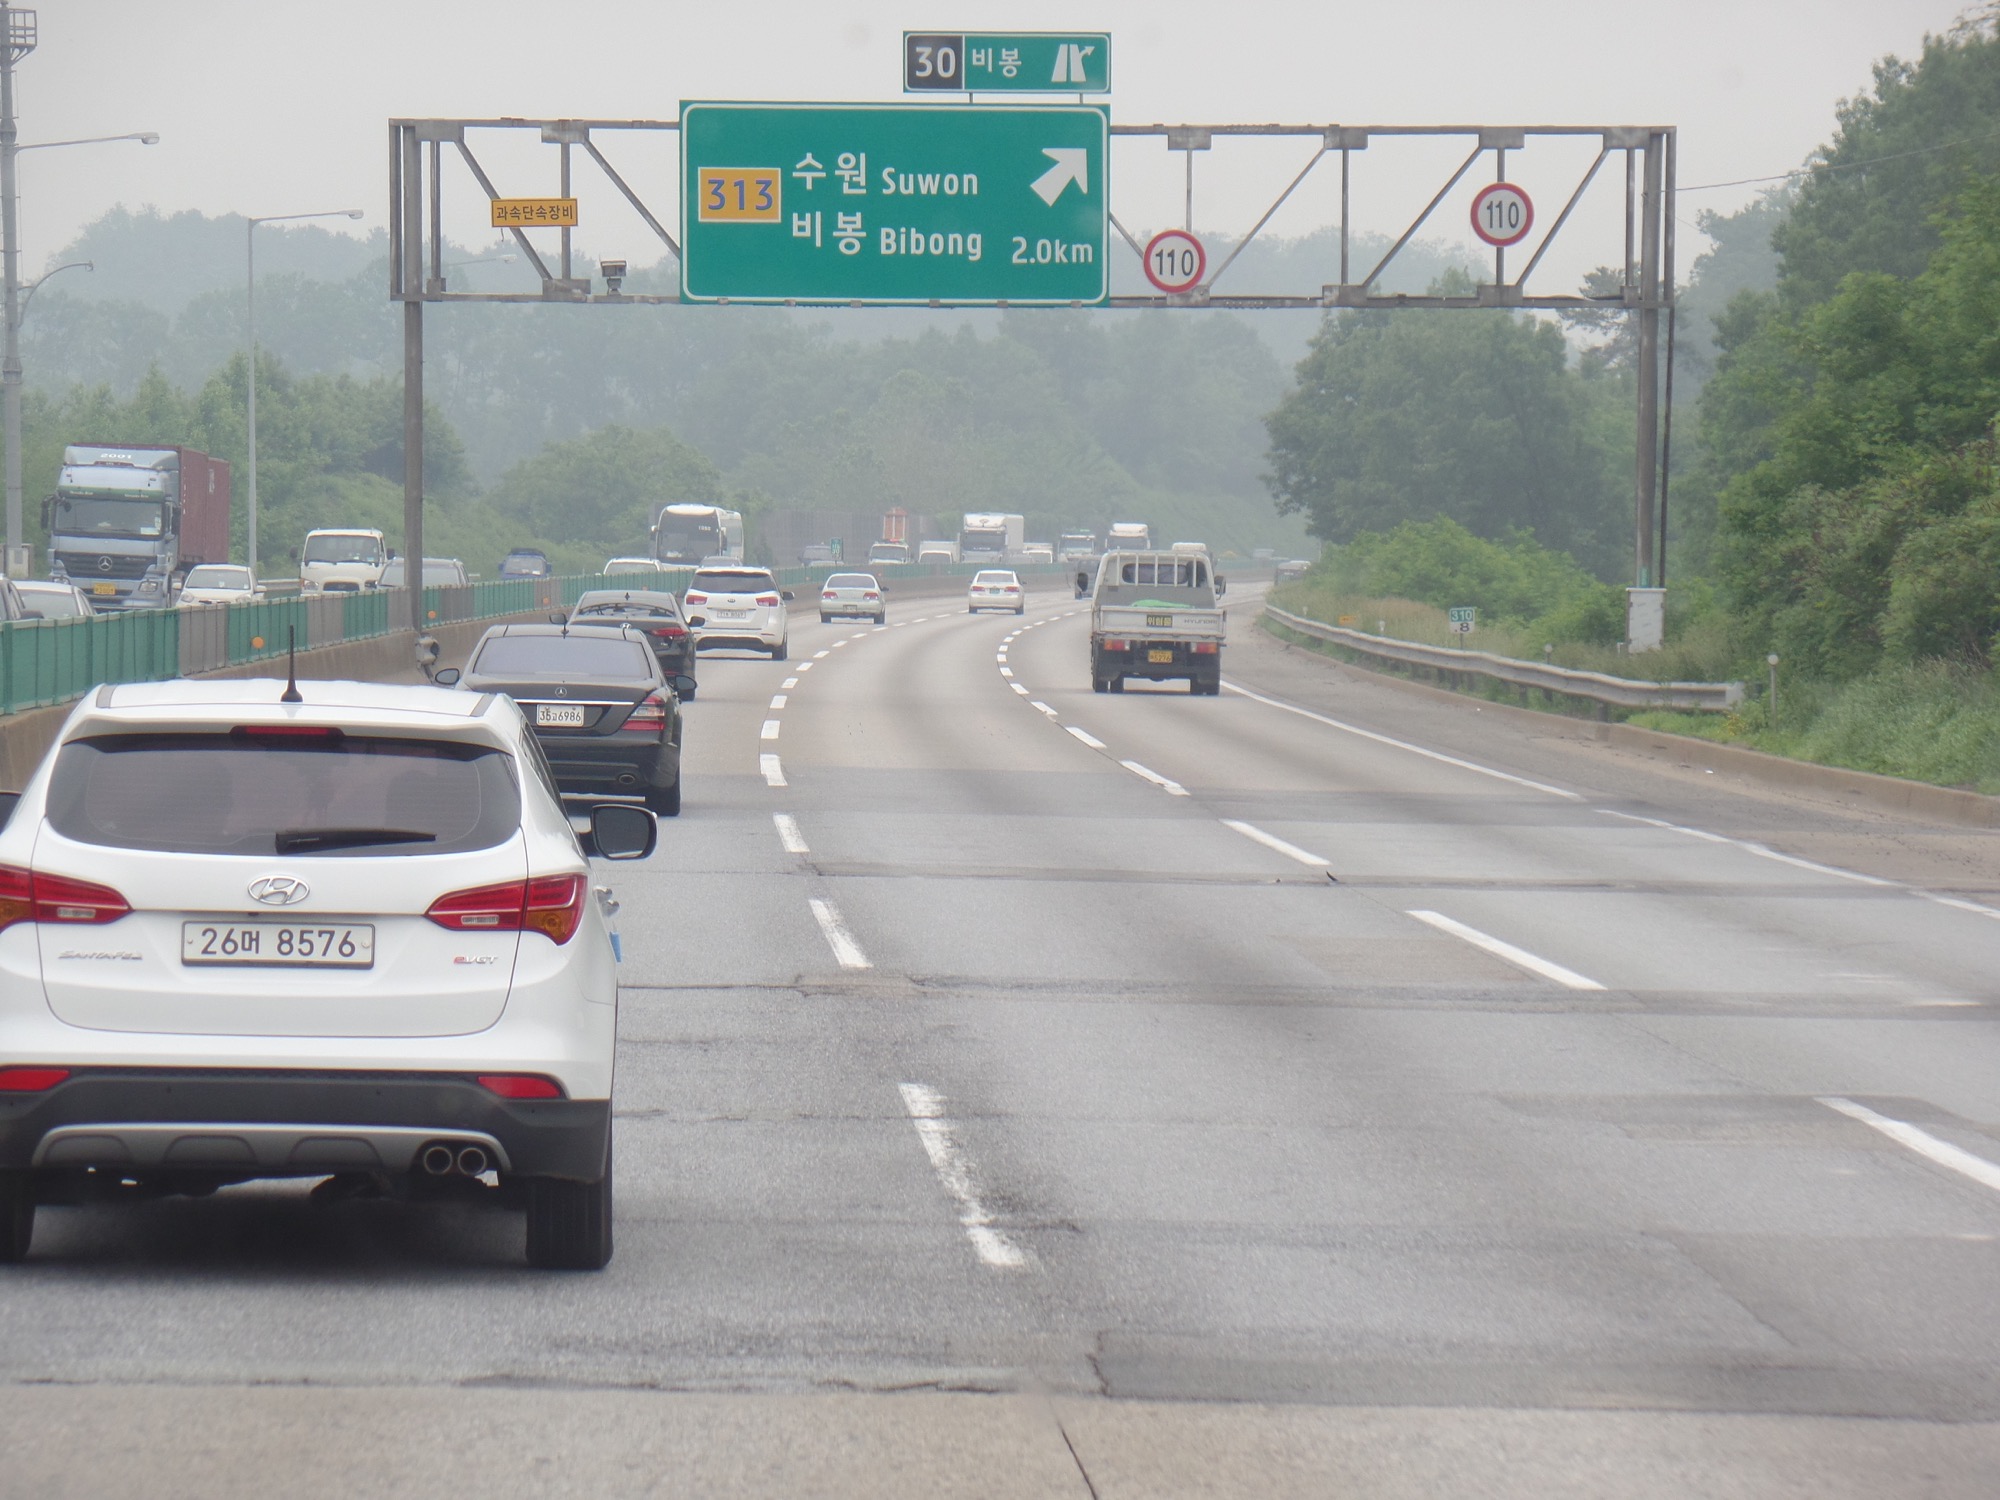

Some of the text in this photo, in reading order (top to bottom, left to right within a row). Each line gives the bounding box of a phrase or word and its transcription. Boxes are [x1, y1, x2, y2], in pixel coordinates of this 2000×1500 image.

[915, 46, 956, 78] 30
[972, 47, 1022, 78] 비봉
[792, 152, 978, 195] 수원 Suwon
[707, 178, 774, 211] 313
[496, 204, 573, 221] 과속단속장비
[1486, 200, 1519, 229] 110
[792, 211, 982, 261] 비봉 Bibong
[1012, 236, 1093, 264] 2.0km
[1155, 248, 1194, 277] 110
[1450, 609, 1474, 622] 310
[200, 927, 356, 958] 26머 8576
